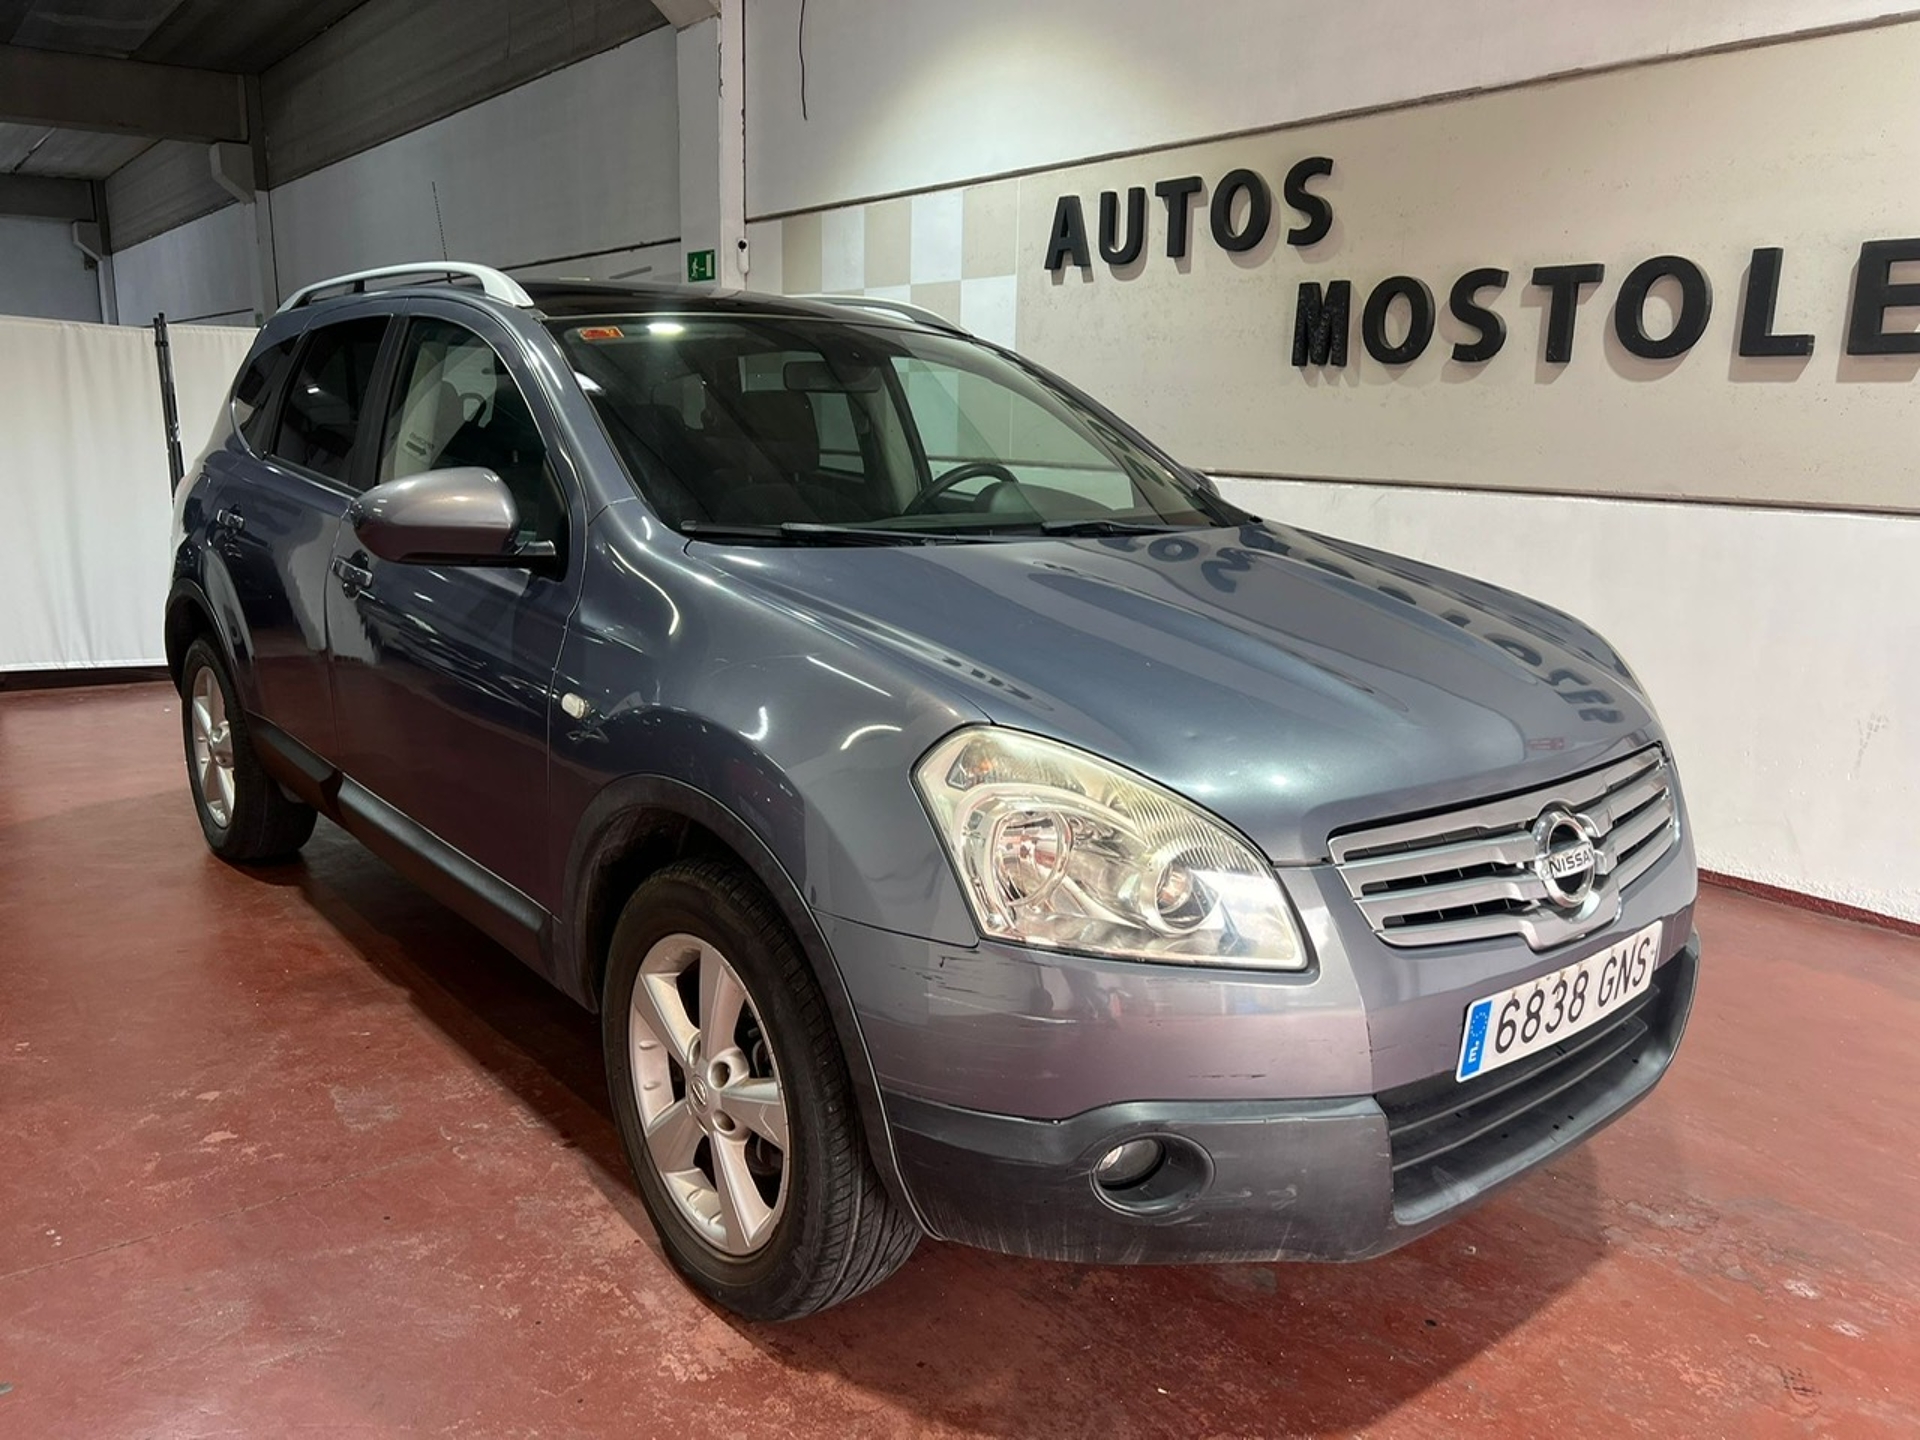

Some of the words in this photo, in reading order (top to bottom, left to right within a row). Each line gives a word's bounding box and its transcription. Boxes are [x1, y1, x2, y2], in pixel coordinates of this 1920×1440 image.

[1045, 157, 1333, 270] AUTOS
[1291, 238, 1920, 368] MOSTOLE
[1495, 970, 1589, 1054] 6838
[1598, 936, 1651, 1007] GNS
[1468, 1046, 1479, 1063] E
